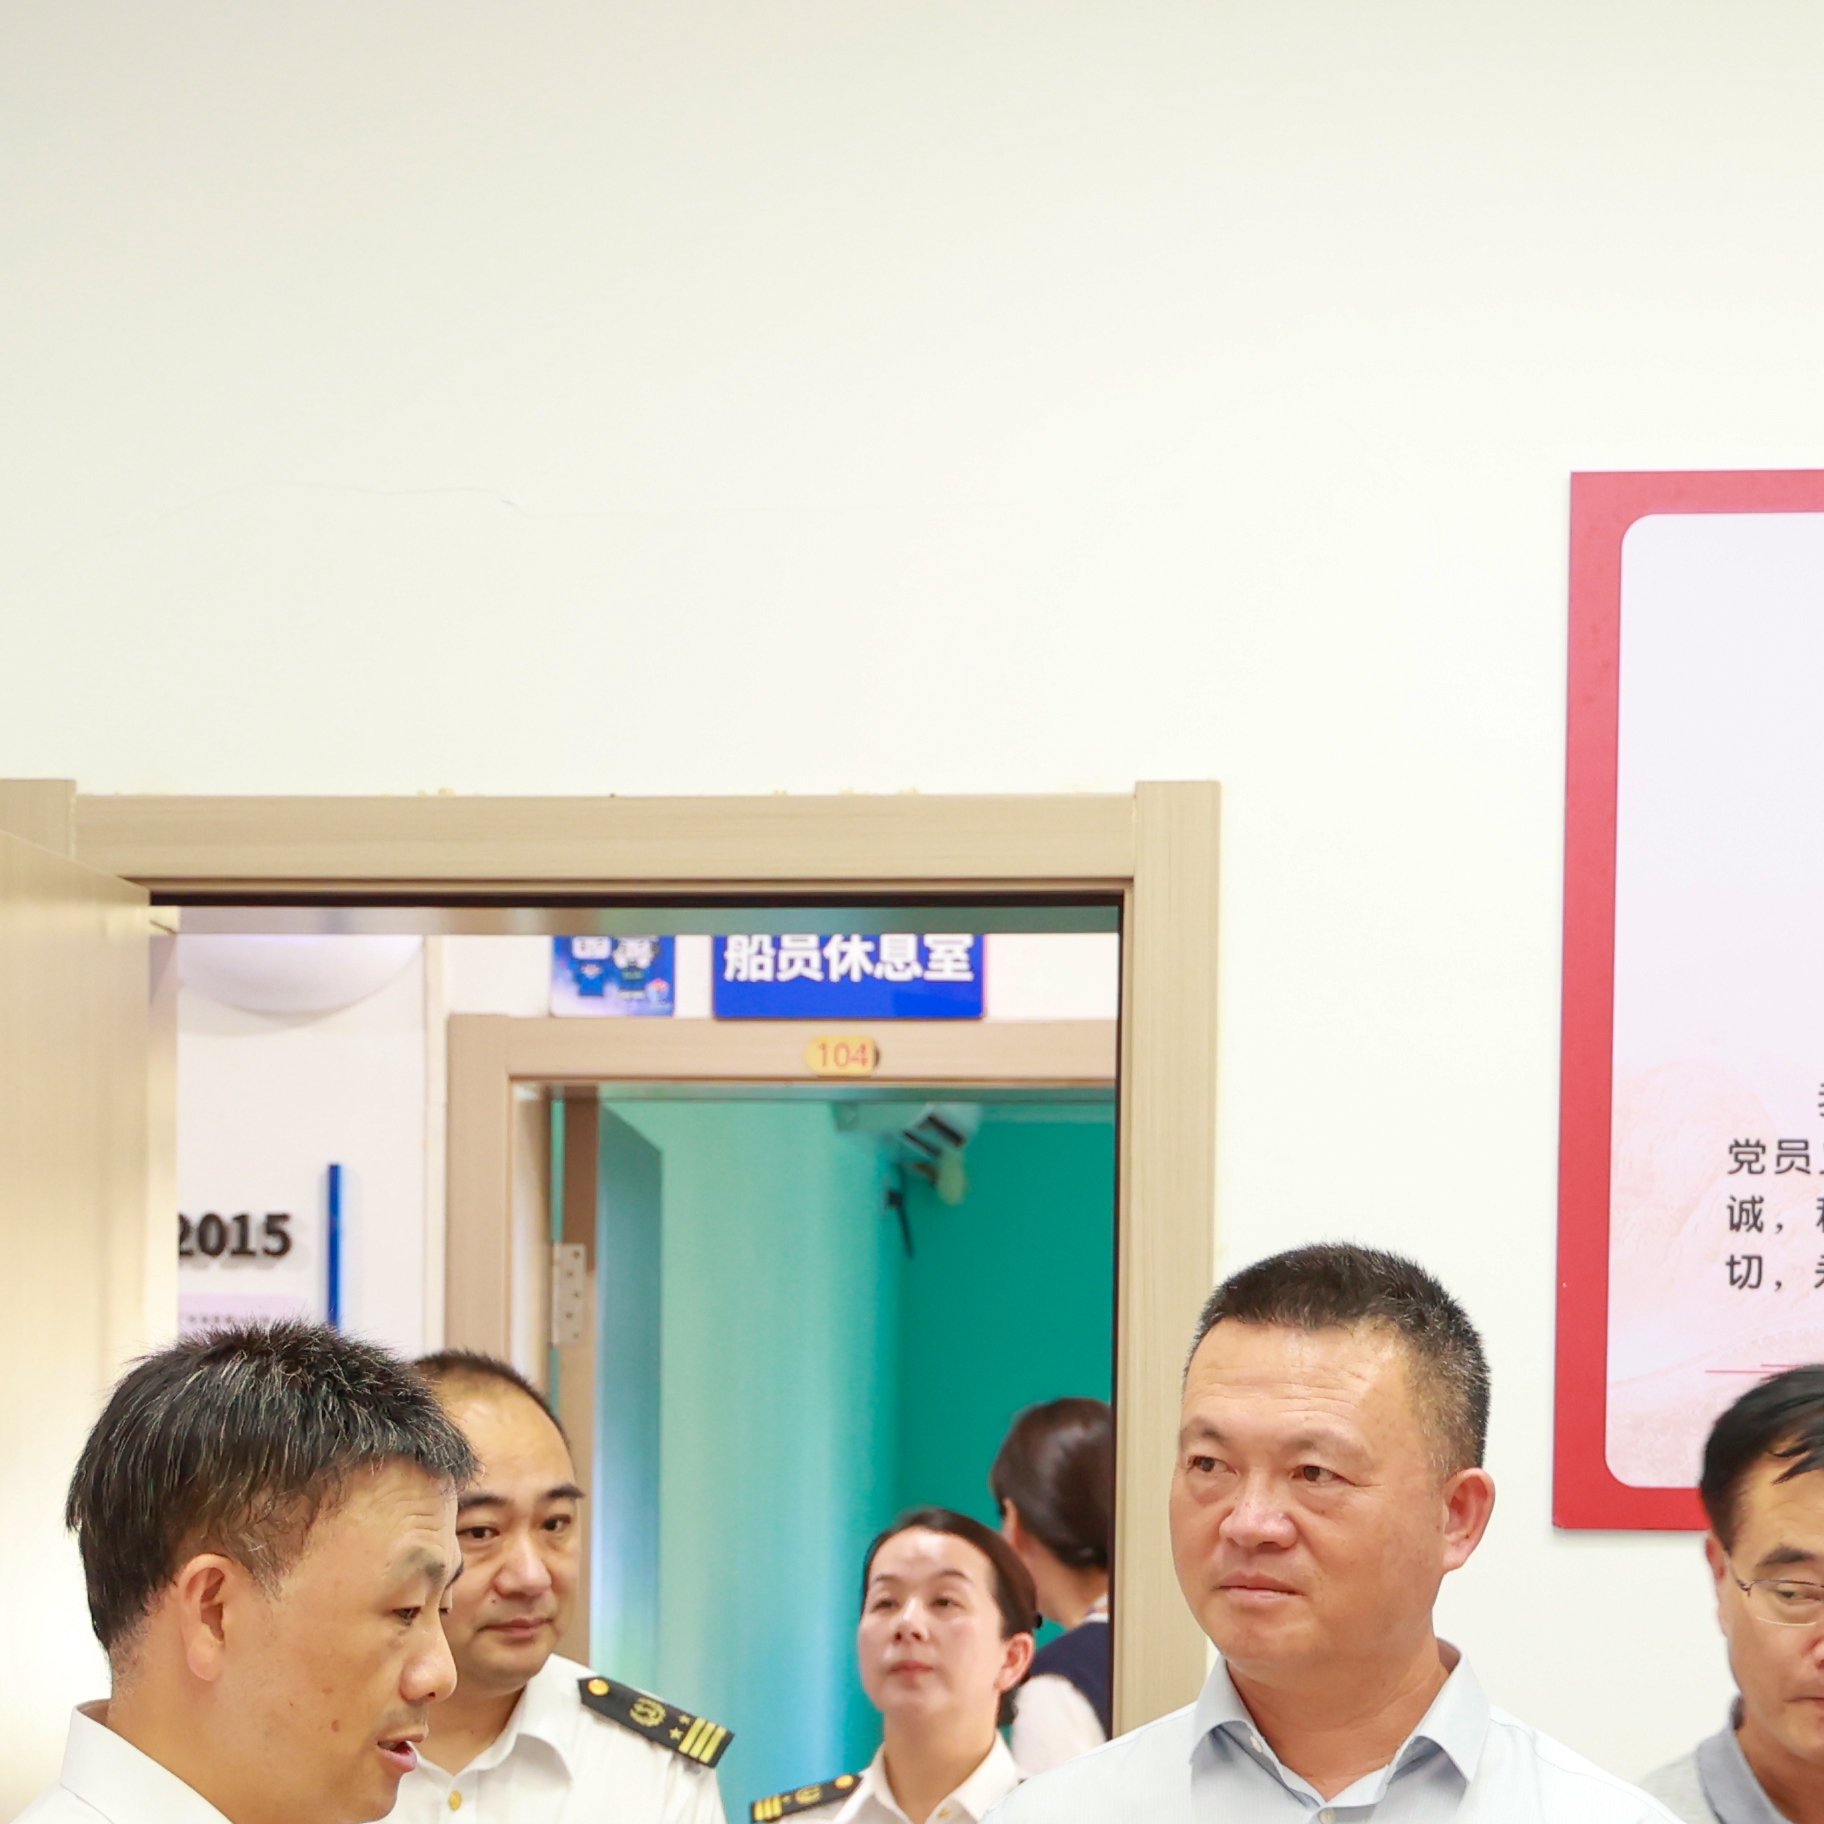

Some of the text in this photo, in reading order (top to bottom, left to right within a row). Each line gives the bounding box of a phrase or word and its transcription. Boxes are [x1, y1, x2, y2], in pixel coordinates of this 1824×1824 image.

[724, 933, 974, 983] 船员休息室
[819, 1041, 868, 1068] 104
[179, 1213, 292, 1259] 2015
